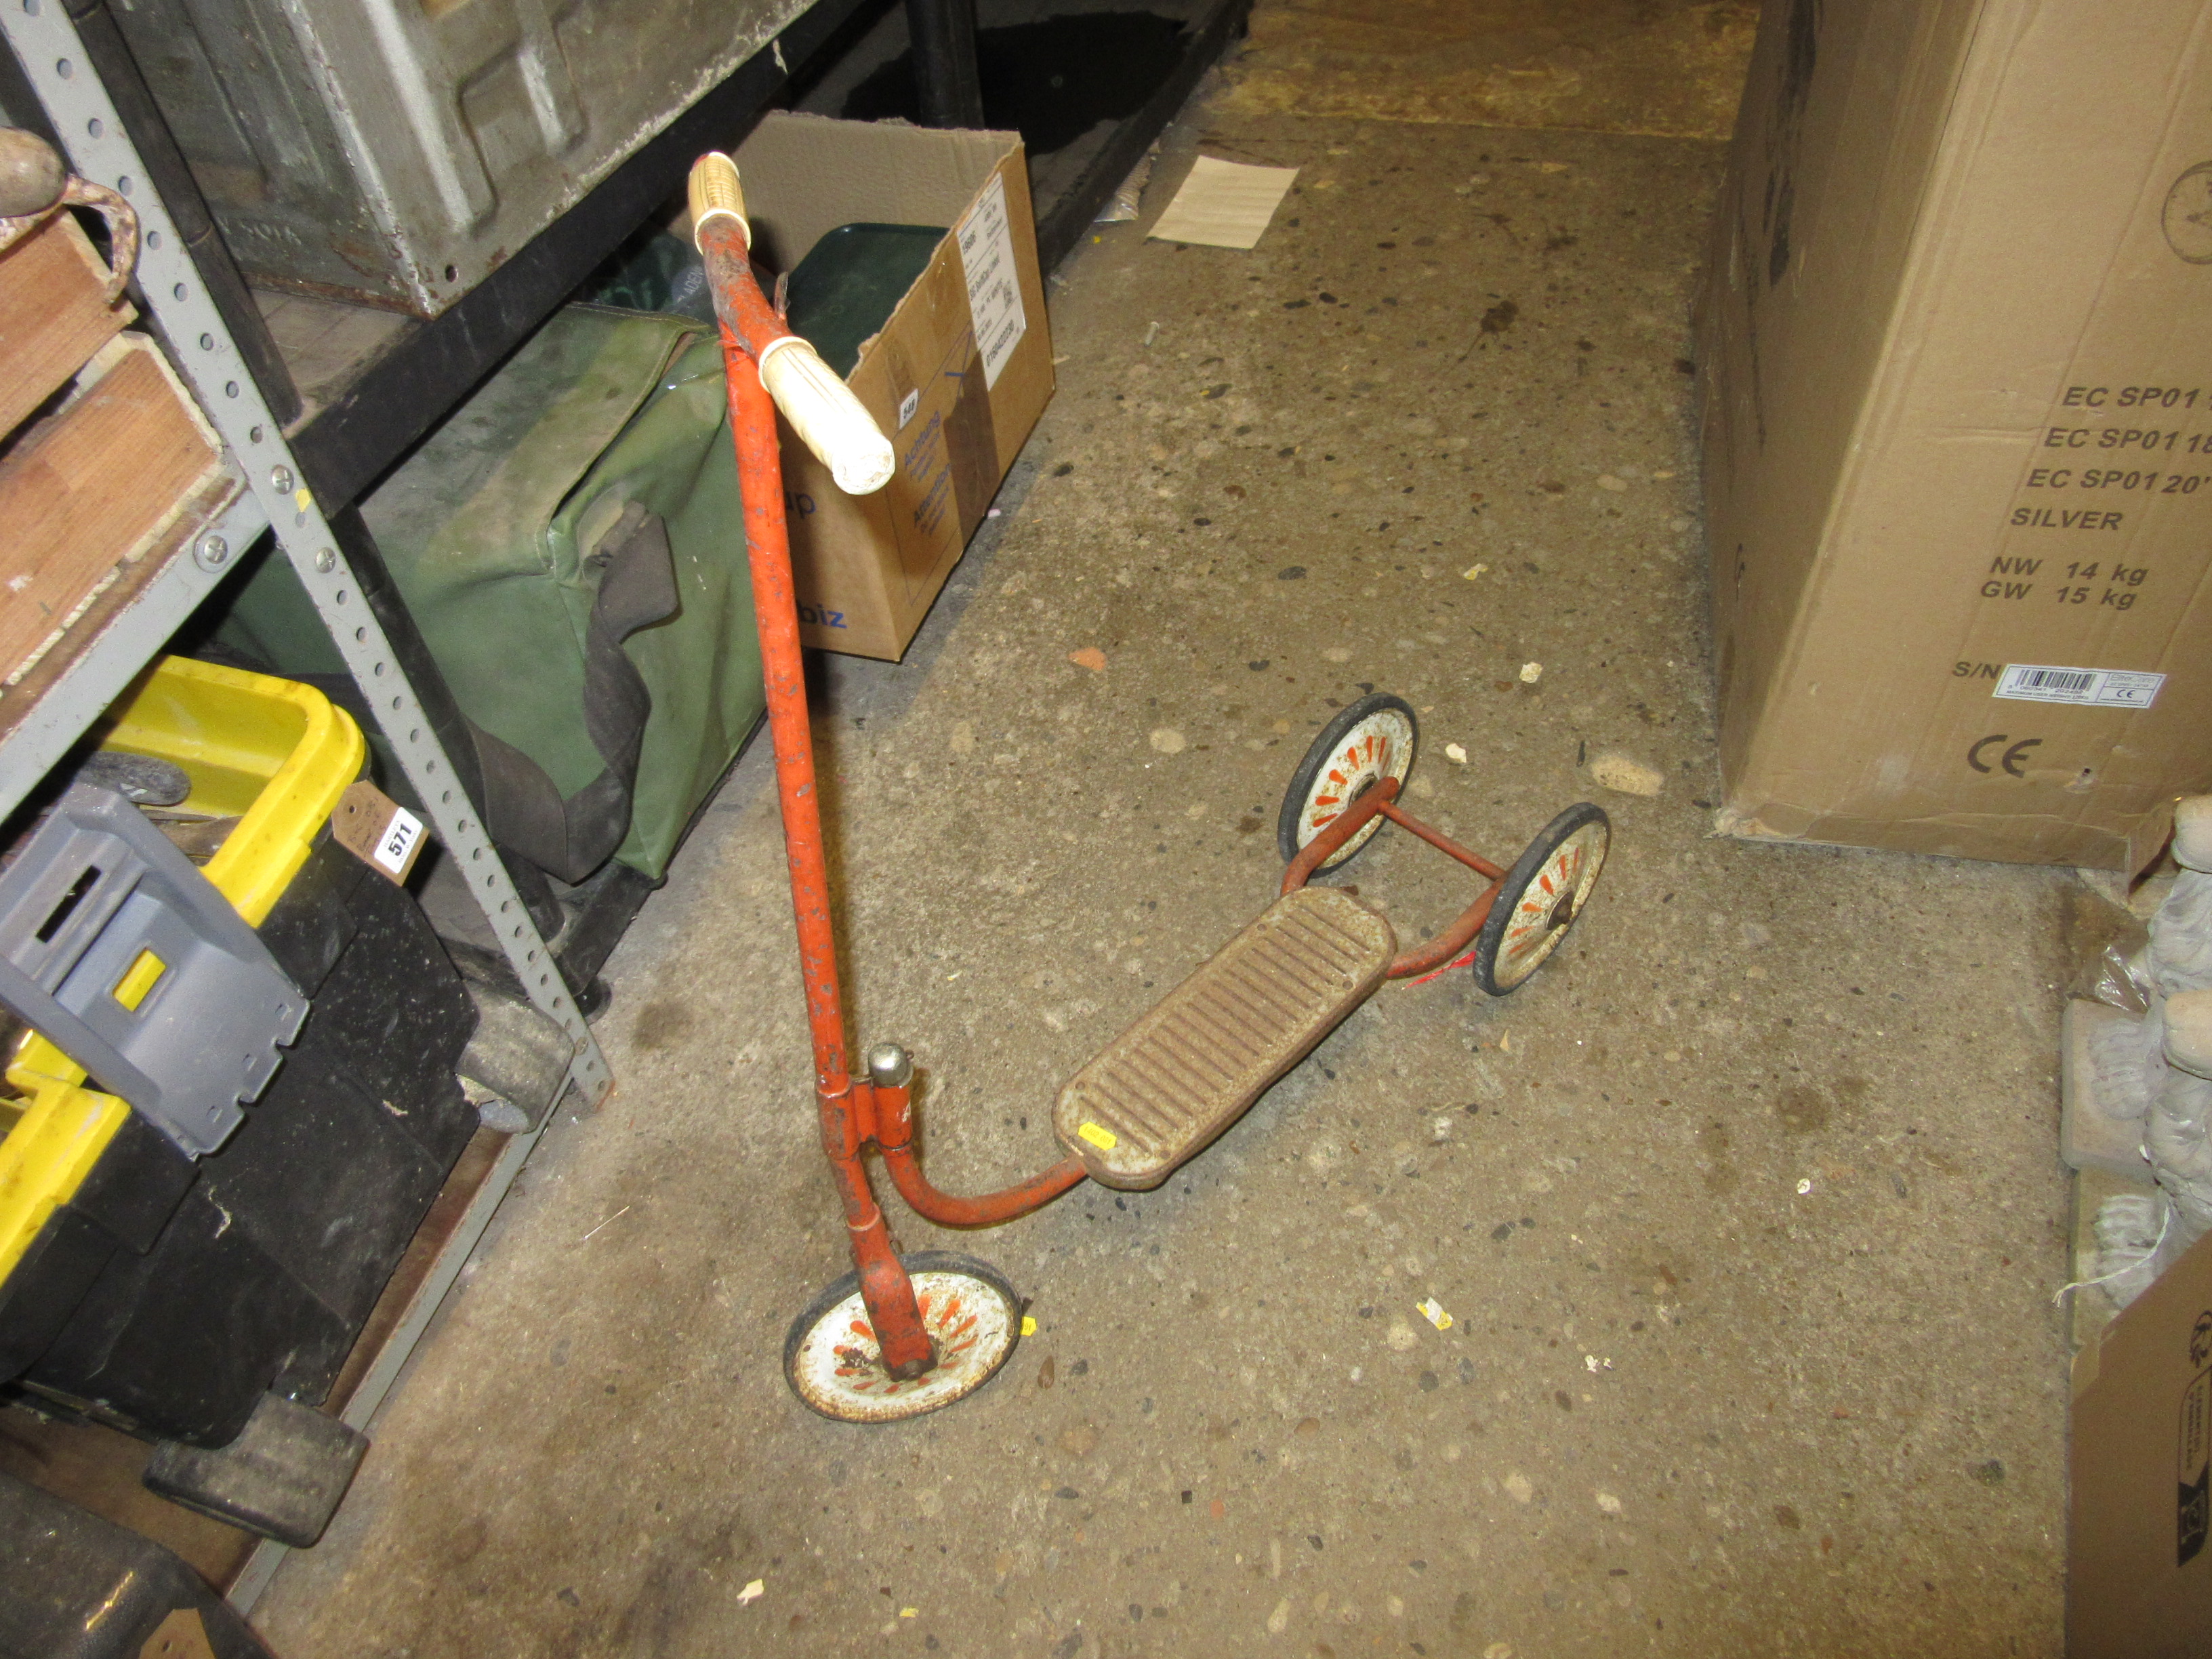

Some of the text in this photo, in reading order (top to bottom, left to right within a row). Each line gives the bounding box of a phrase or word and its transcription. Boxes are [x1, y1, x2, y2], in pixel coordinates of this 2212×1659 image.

[2062, 386, 2108, 407] EC
[2117, 386, 2200, 409] SP01
[905, 410, 941, 470] Achtung
[2044, 427, 2089, 448] EC
[2098, 428, 2179, 451] SP01
[2027, 468, 2071, 488] EC
[2080, 469, 2158, 491] SP01
[2010, 508, 2123, 531] SILVER
[1989, 556, 2150, 586] NW 14 kg
[1980, 581, 2137, 611] GW 15 kg
[1952, 661, 2001, 680] S/N
[388, 823, 412, 857] 571
